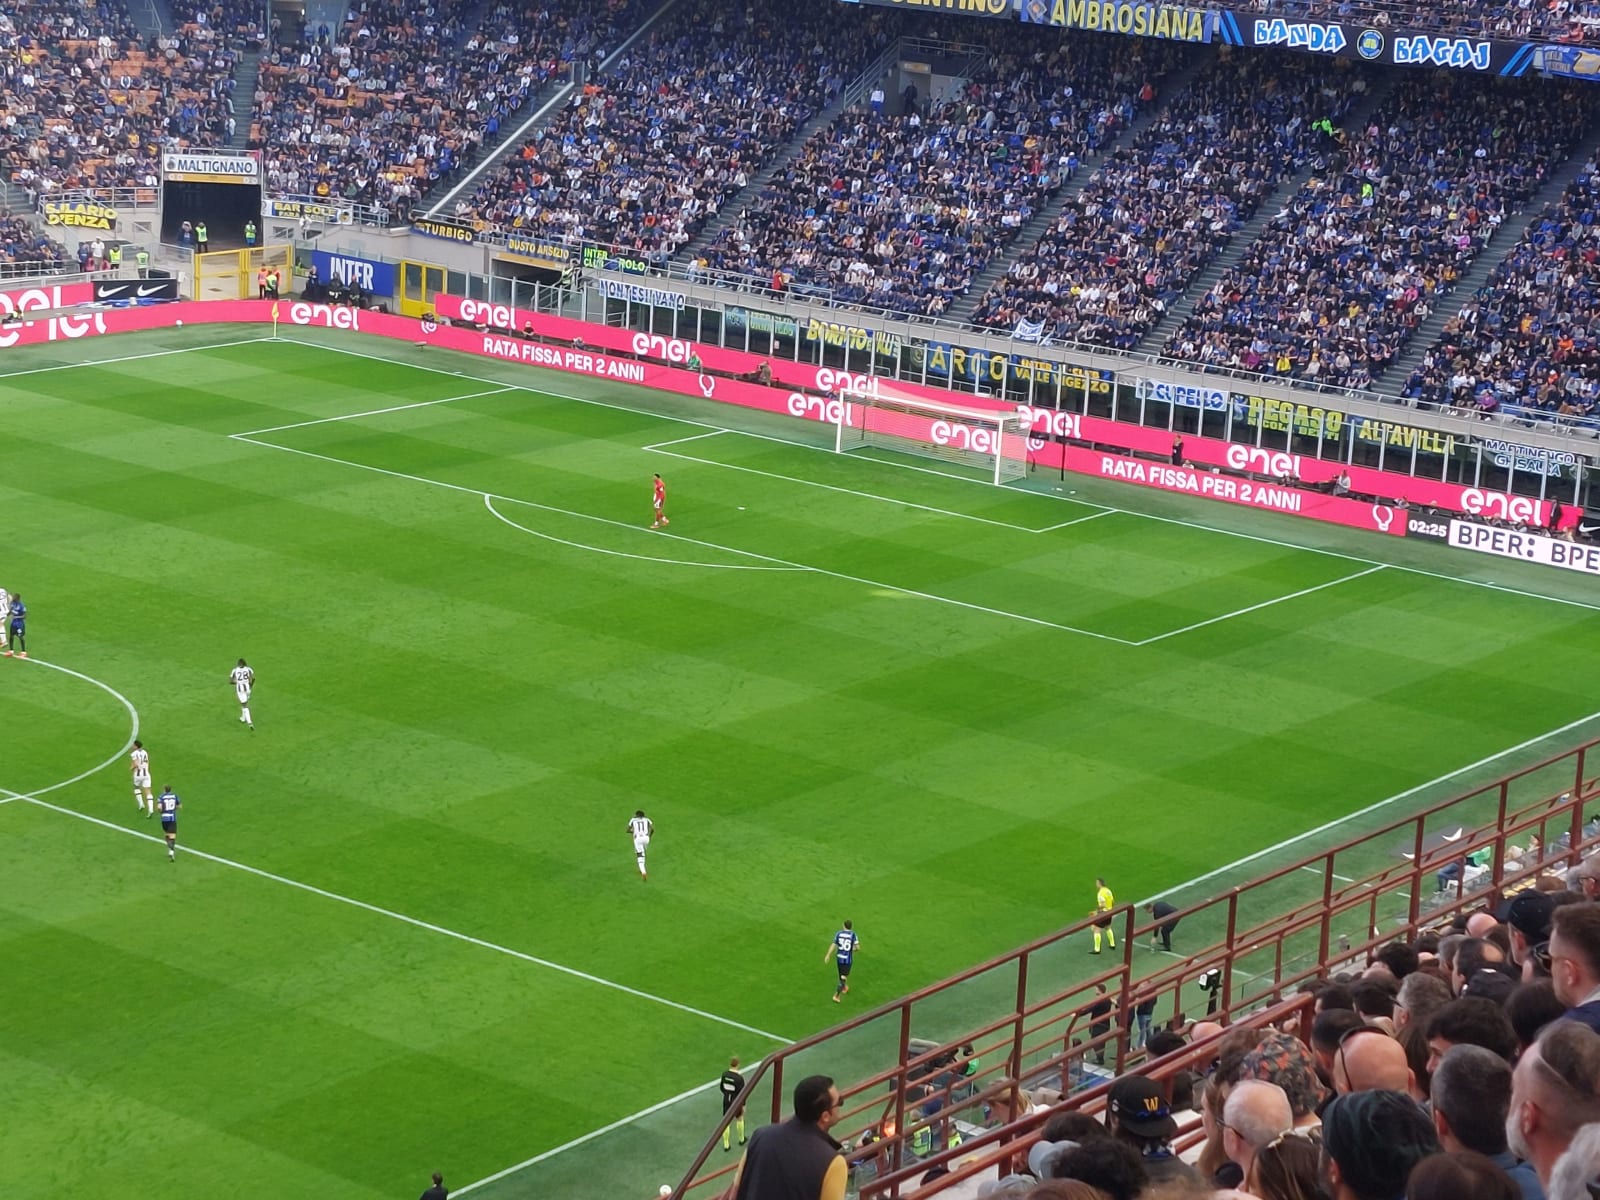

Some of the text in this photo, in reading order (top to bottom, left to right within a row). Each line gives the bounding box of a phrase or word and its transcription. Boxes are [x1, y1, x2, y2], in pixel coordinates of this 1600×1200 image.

[1050, 0, 1204, 41] AMBROSIANA
[1254, 19, 1347, 53] BANDA
[177, 158, 254, 174] MALTIGNANO
[48, 213, 111, 230] D'ENZA
[424, 223, 473, 242] TURBIGO
[584, 247, 608, 261] INTER
[330, 257, 374, 290] INTER
[290, 303, 360, 331] enel
[460, 300, 516, 330] enel
[484, 338, 645, 382] RATA FISSA PER 2 ANNI
[632, 333, 692, 363] enel
[930, 346, 1006, 380] ARCO
[816, 368, 879, 398] enel
[1015, 366, 1051, 383] VALE
[787, 393, 853, 426] enel
[1016, 405, 1081, 439] enel
[1248, 396, 1343, 433] PEGASO
[931, 421, 999, 455] enel
[1358, 419, 1456, 456] ALTAVILLA
[1226, 445, 1301, 478] enel
[1101, 457, 1301, 512] RATA FISSA PER 2 ANNI
[1461, 488, 1542, 526] enel
[1408, 519, 1448, 538] 02:25
[838, 937, 852, 952] 36
[1143, 1096, 1159, 1112] W
